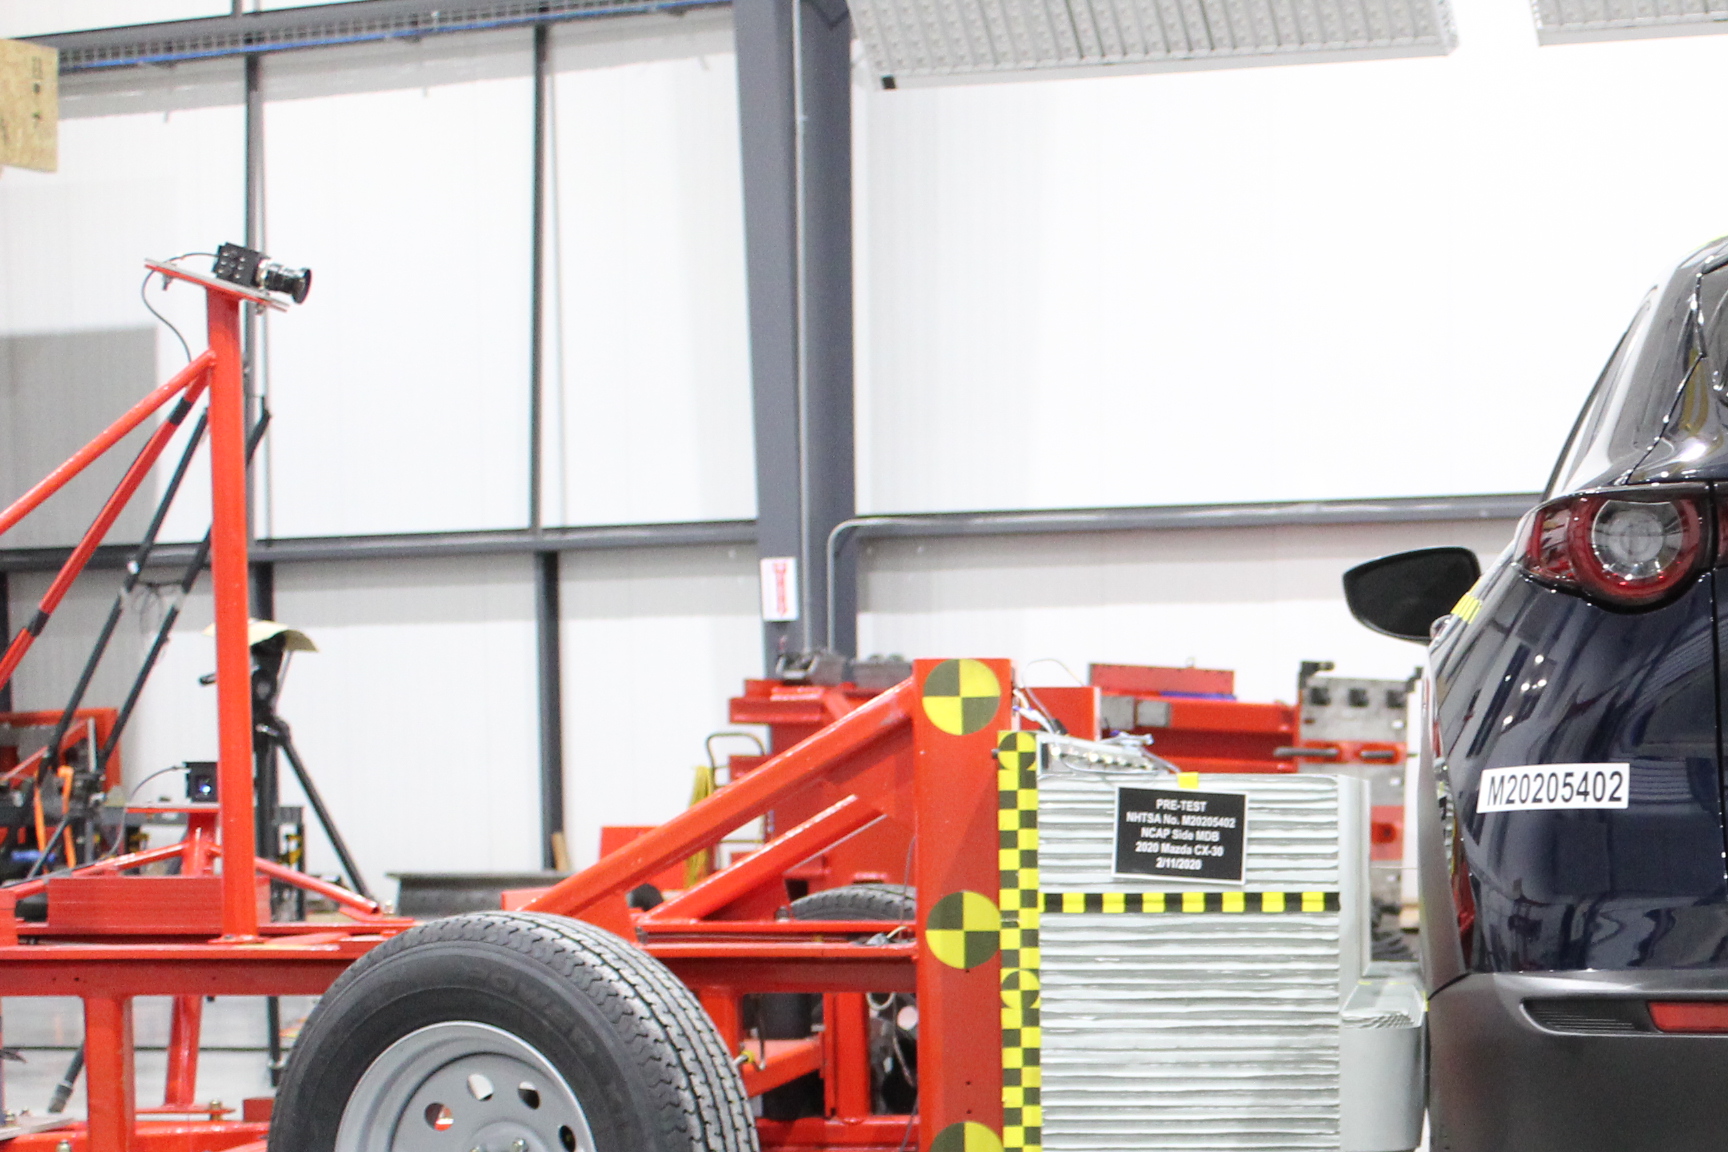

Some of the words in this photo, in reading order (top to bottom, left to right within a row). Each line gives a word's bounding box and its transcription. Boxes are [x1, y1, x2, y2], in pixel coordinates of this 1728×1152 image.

[1487, 770, 1623, 806] M20205402
[1156, 798, 1208, 812] PRE-TEST
[1126, 811, 1162, 824] NHTSA
[1163, 814, 1180, 826] No.
[1181, 815, 1236, 828] M20205402
[1140, 827, 1171, 839] NCAP
[1171, 829, 1193, 841] Side
[1195, 831, 1220, 842] MDB
[1135, 841, 1160, 853] 2020
[1161, 843, 1193, 855] Mazda
[1194, 844, 1225, 857] CX-30
[1155, 857, 1203, 870] 2/11/2020
